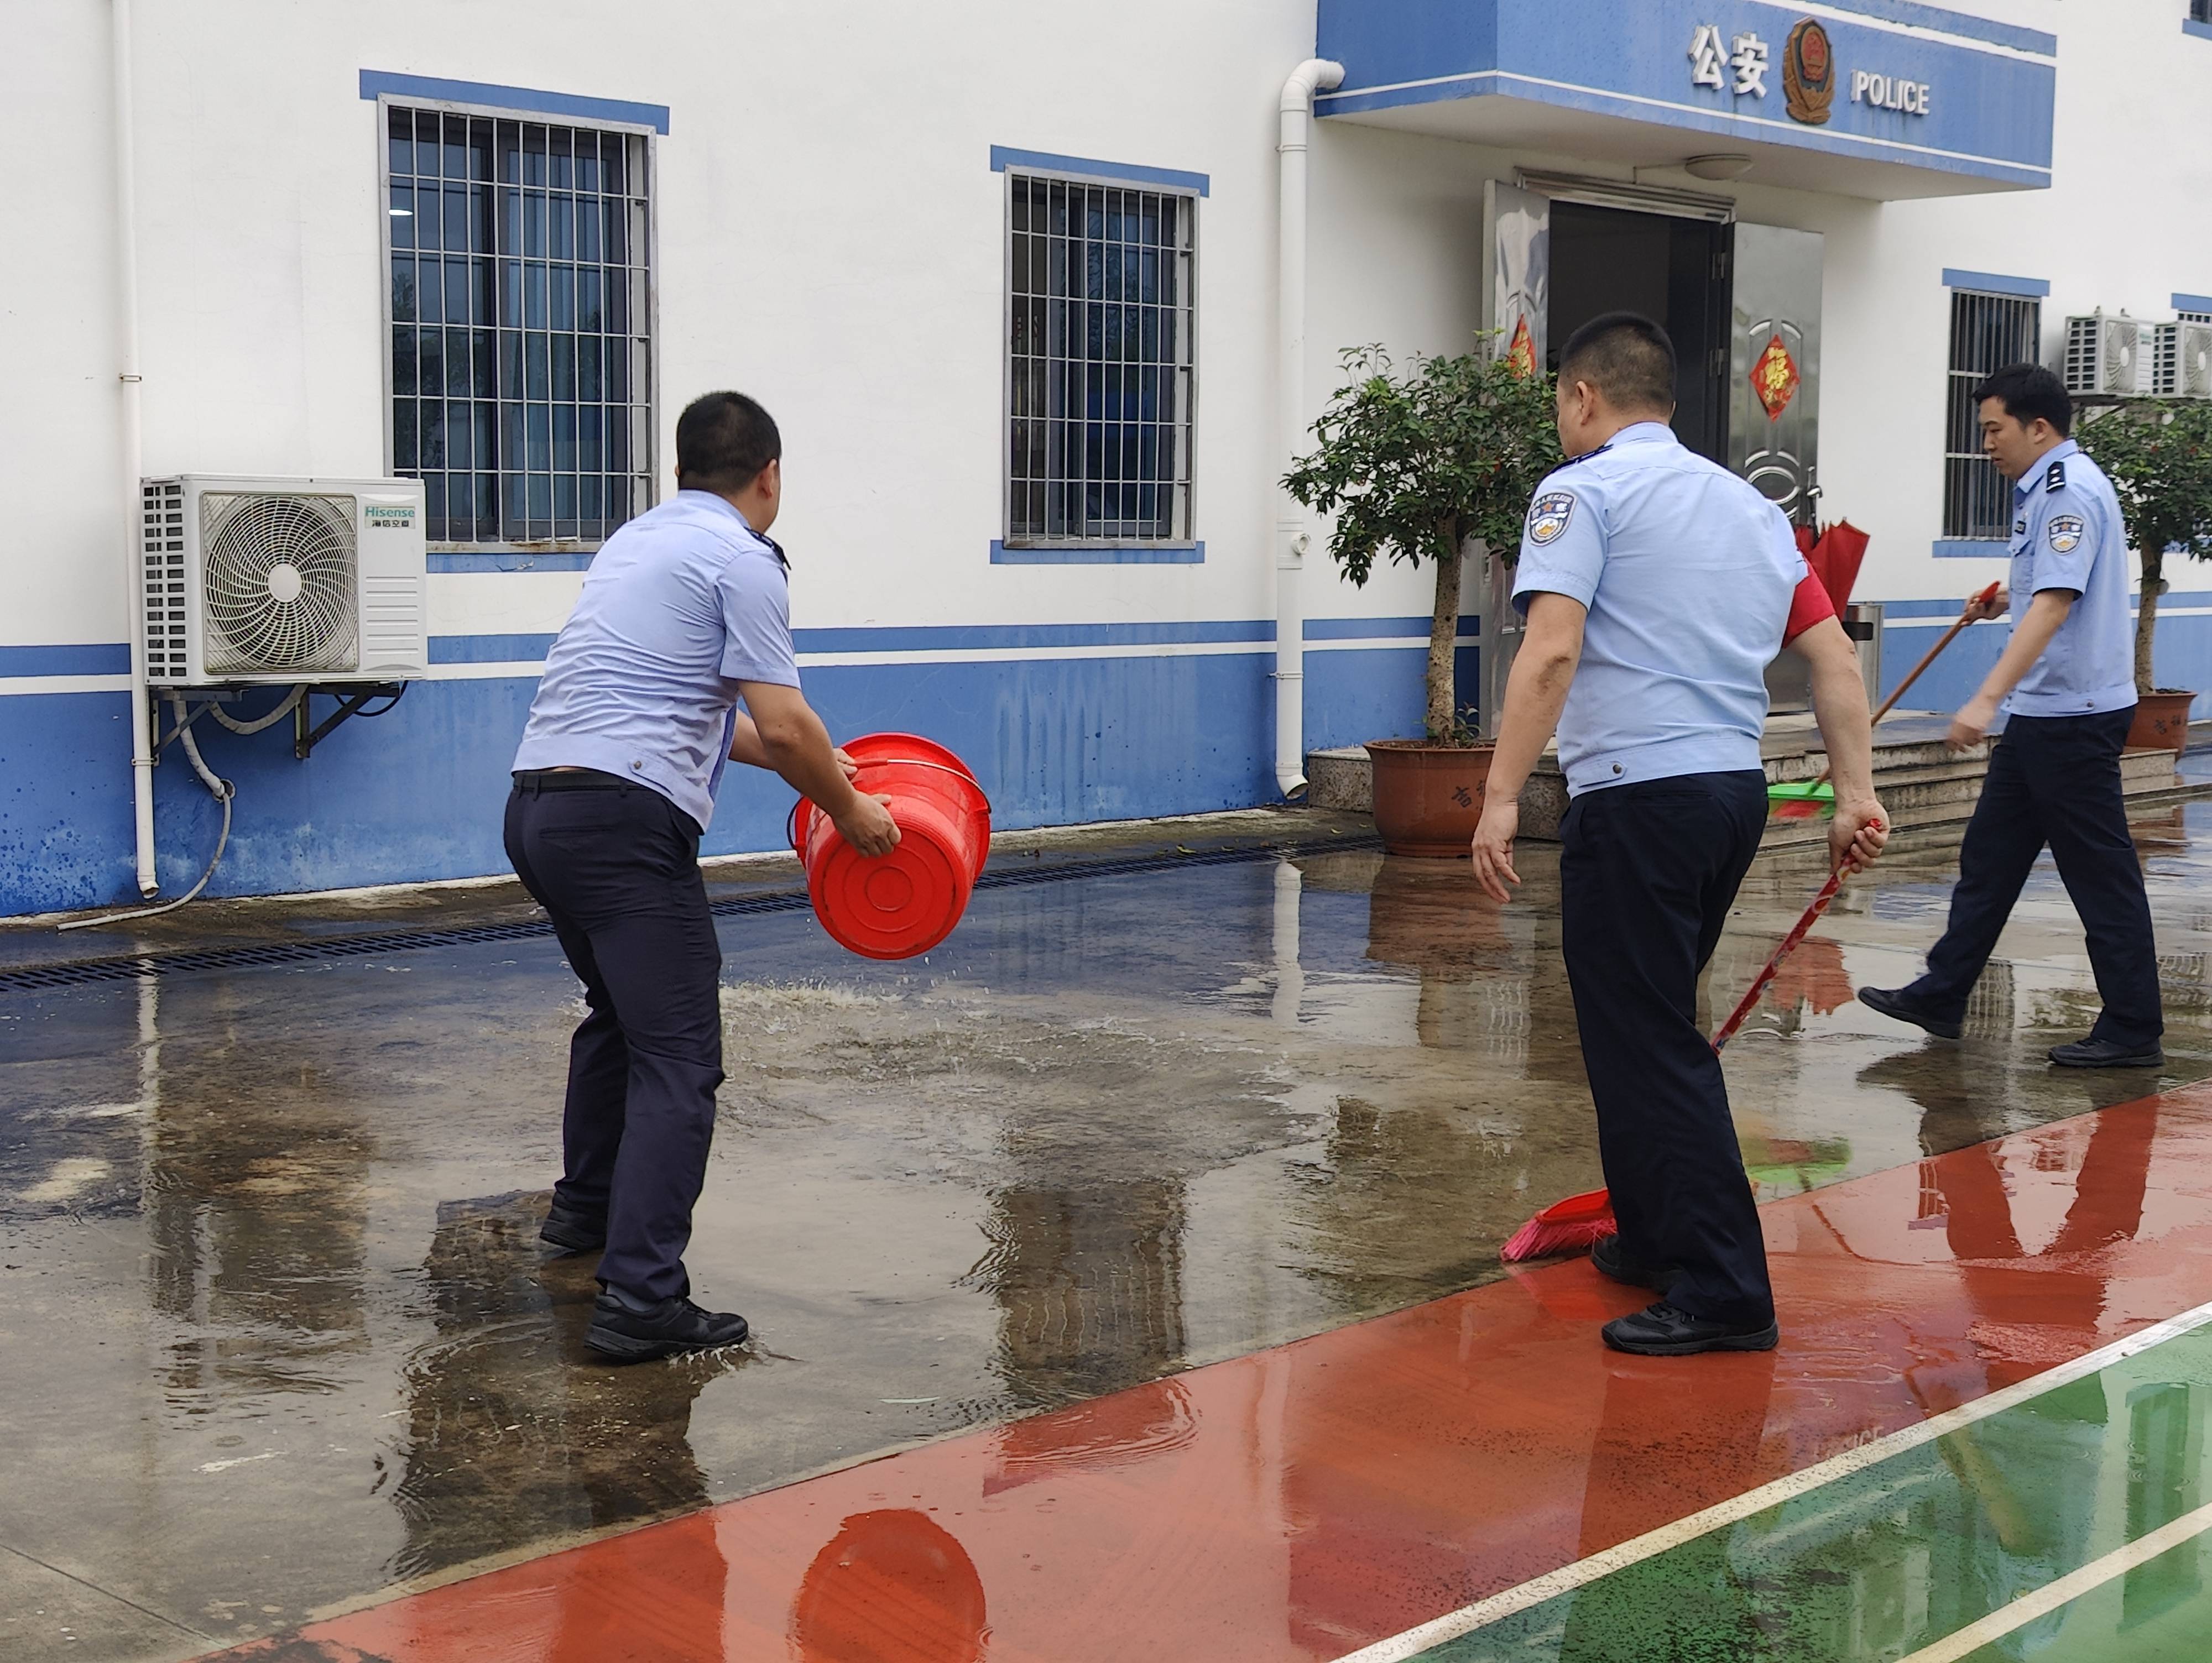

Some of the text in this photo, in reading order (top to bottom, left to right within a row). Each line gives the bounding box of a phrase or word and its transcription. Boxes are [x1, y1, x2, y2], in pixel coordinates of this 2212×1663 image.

[1687, 24, 1769, 98] 公安
[1850, 69, 1929, 115] POLICE
[365, 506, 415, 517] Hisense
